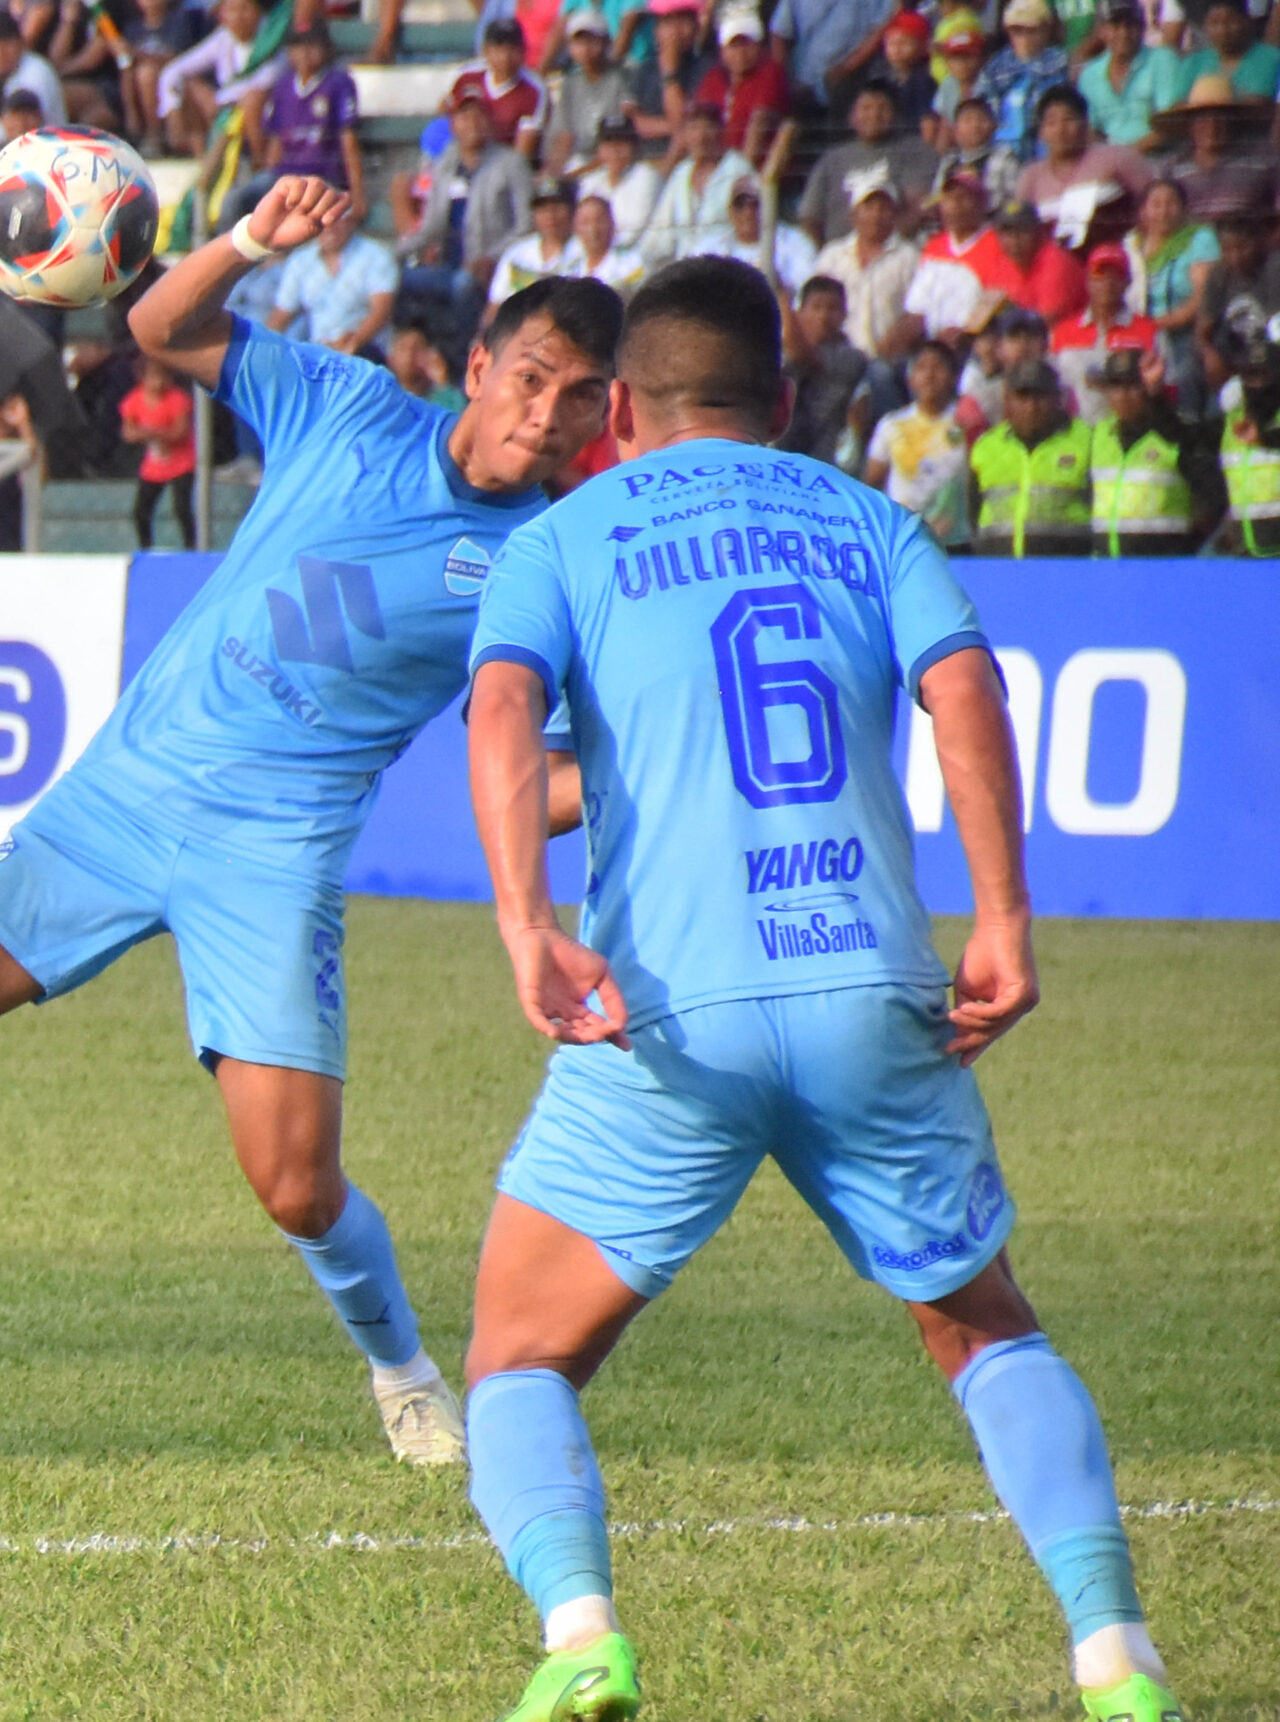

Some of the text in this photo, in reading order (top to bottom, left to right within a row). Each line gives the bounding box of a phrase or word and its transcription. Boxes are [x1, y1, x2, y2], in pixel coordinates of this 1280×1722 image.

[621, 460, 840, 500] PACEÑA
[650, 479, 726, 504] CERVEZA
[651, 498, 872, 532] BANCO GANADERO
[221, 636, 323, 727] SUZUKI
[709, 582, 849, 810] 6
[744, 835, 865, 895] YANGO
[756, 911, 879, 961] VillaSanta
